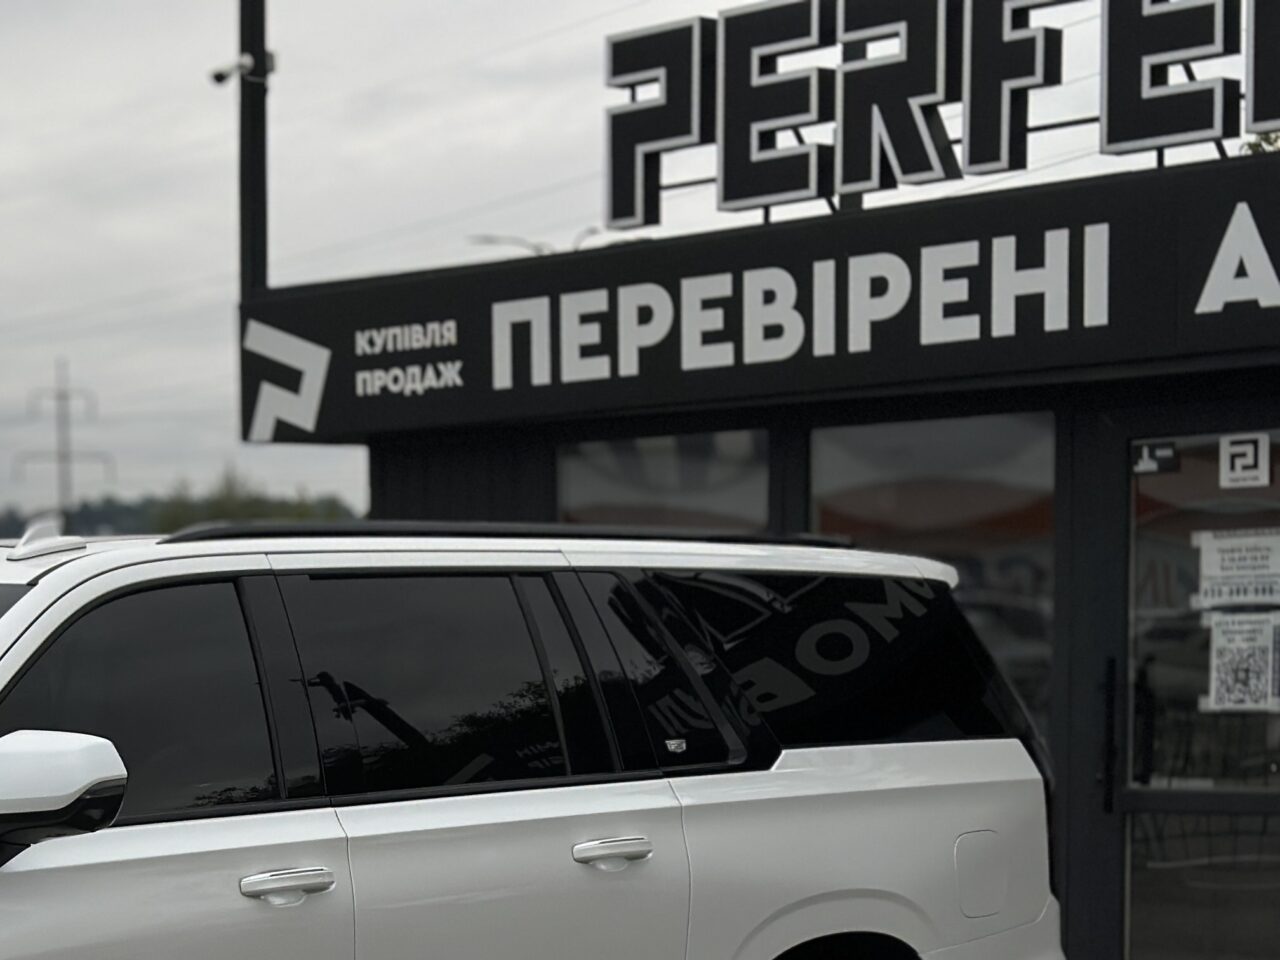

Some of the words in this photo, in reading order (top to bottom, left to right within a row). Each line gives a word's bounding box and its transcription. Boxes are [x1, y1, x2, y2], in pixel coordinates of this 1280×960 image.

[491, 222, 1110, 390] ПЕРЕВІРЕНІ
[354, 319, 458, 356] КУПІВЛЯ
[355, 360, 464, 397] ПРОДАЖ
